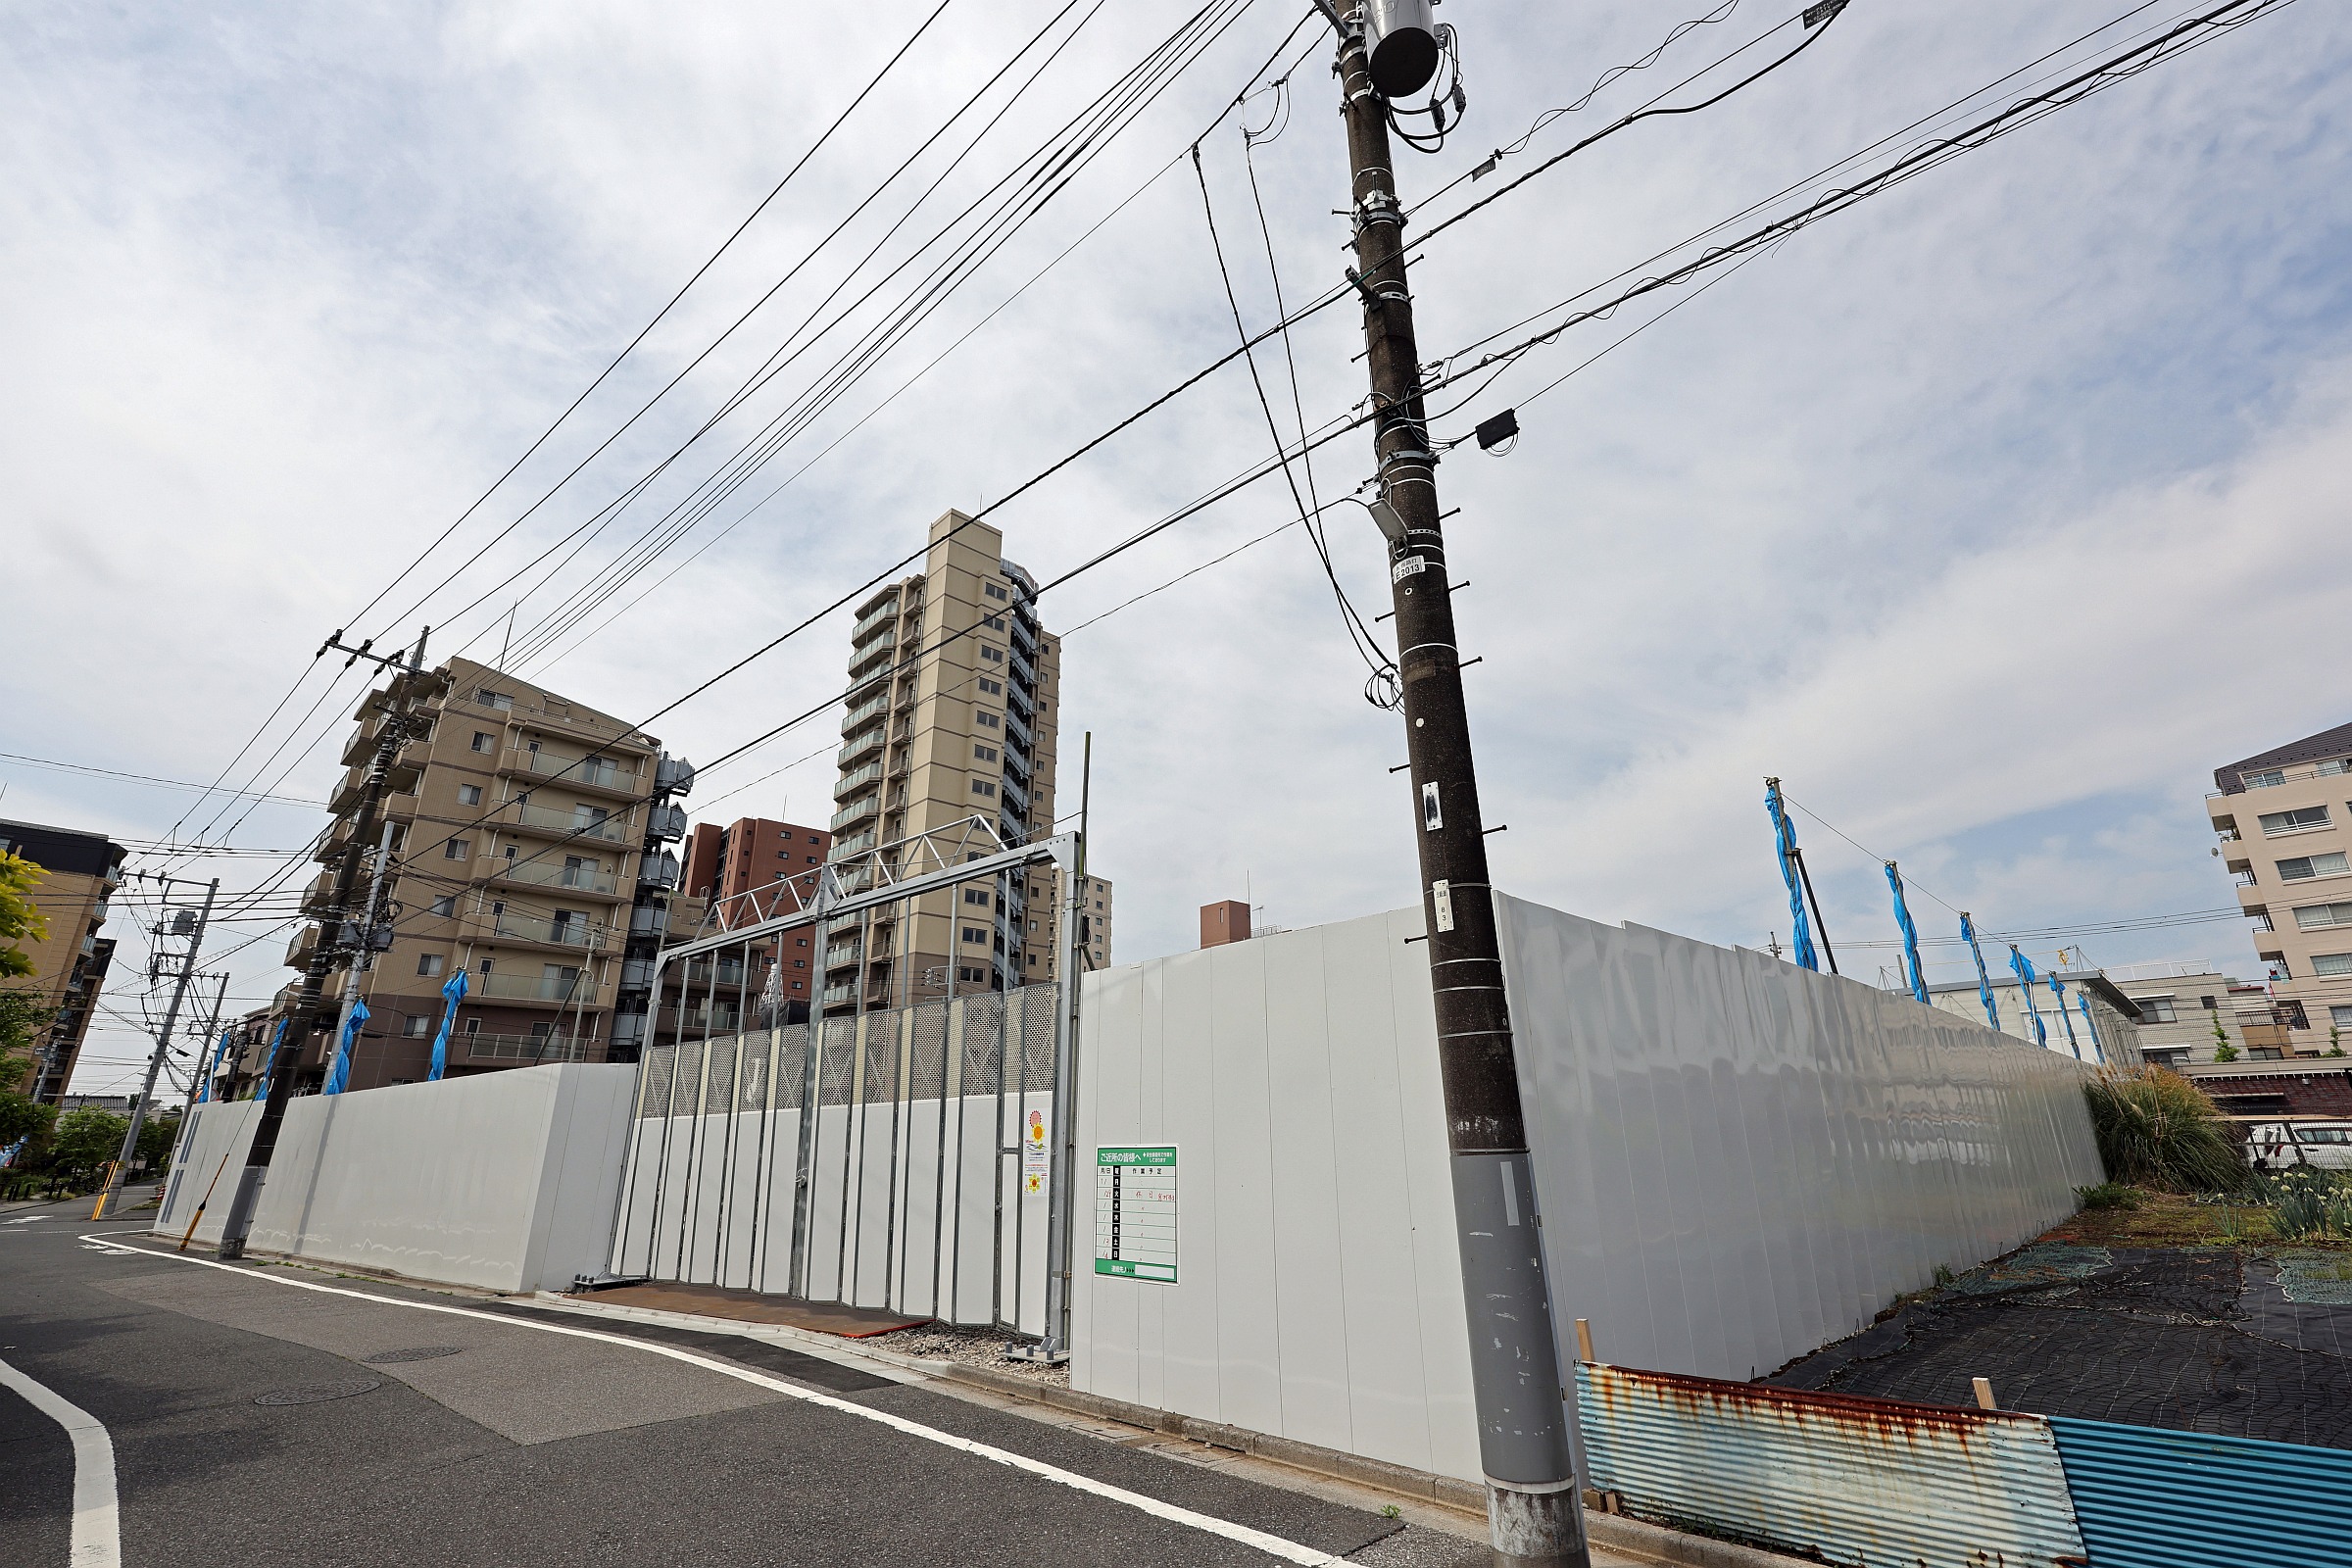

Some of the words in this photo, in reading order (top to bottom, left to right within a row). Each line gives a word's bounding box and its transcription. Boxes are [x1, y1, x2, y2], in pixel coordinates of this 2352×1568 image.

[1396, 564, 1420, 579] E2013
[1101, 1152, 1142, 1163] ご近所の皆様へ
